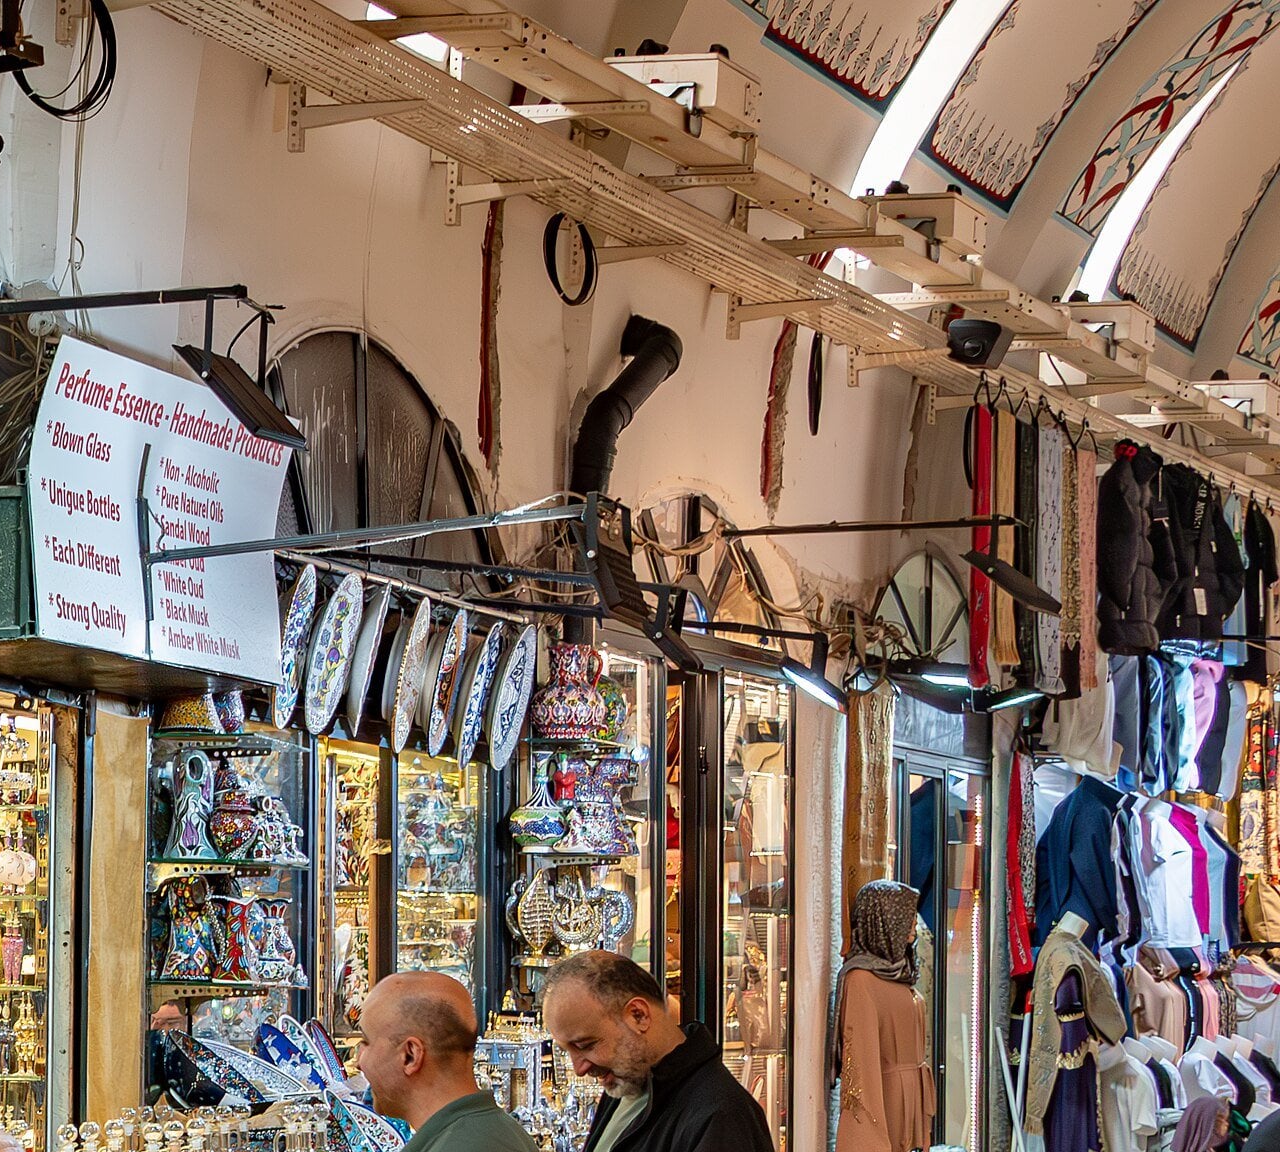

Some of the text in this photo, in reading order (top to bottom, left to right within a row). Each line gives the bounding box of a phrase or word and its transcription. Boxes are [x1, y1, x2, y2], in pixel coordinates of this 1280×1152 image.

[55, 362, 113, 411] Perfume
[112, 382, 164, 428] Essence
[169, 401, 233, 451] Handmade
[232, 423, 285, 467] Products
[52, 421, 112, 463] Blown Glass
[163, 457, 180, 482] Non
[184, 464, 220, 494] Alcoholic
[87, 489, 121, 522] Bottles
[160, 486, 224, 524] Pure Naturel Oils
[160, 514, 210, 546] Sandal Wood
[52, 536, 121, 577] Each Different
[162, 570, 204, 600] White Oud
[56, 593, 127, 638] Strong Quality
[165, 598, 210, 628] Black Musk
[168, 626, 241, 661] Amber White Musk
